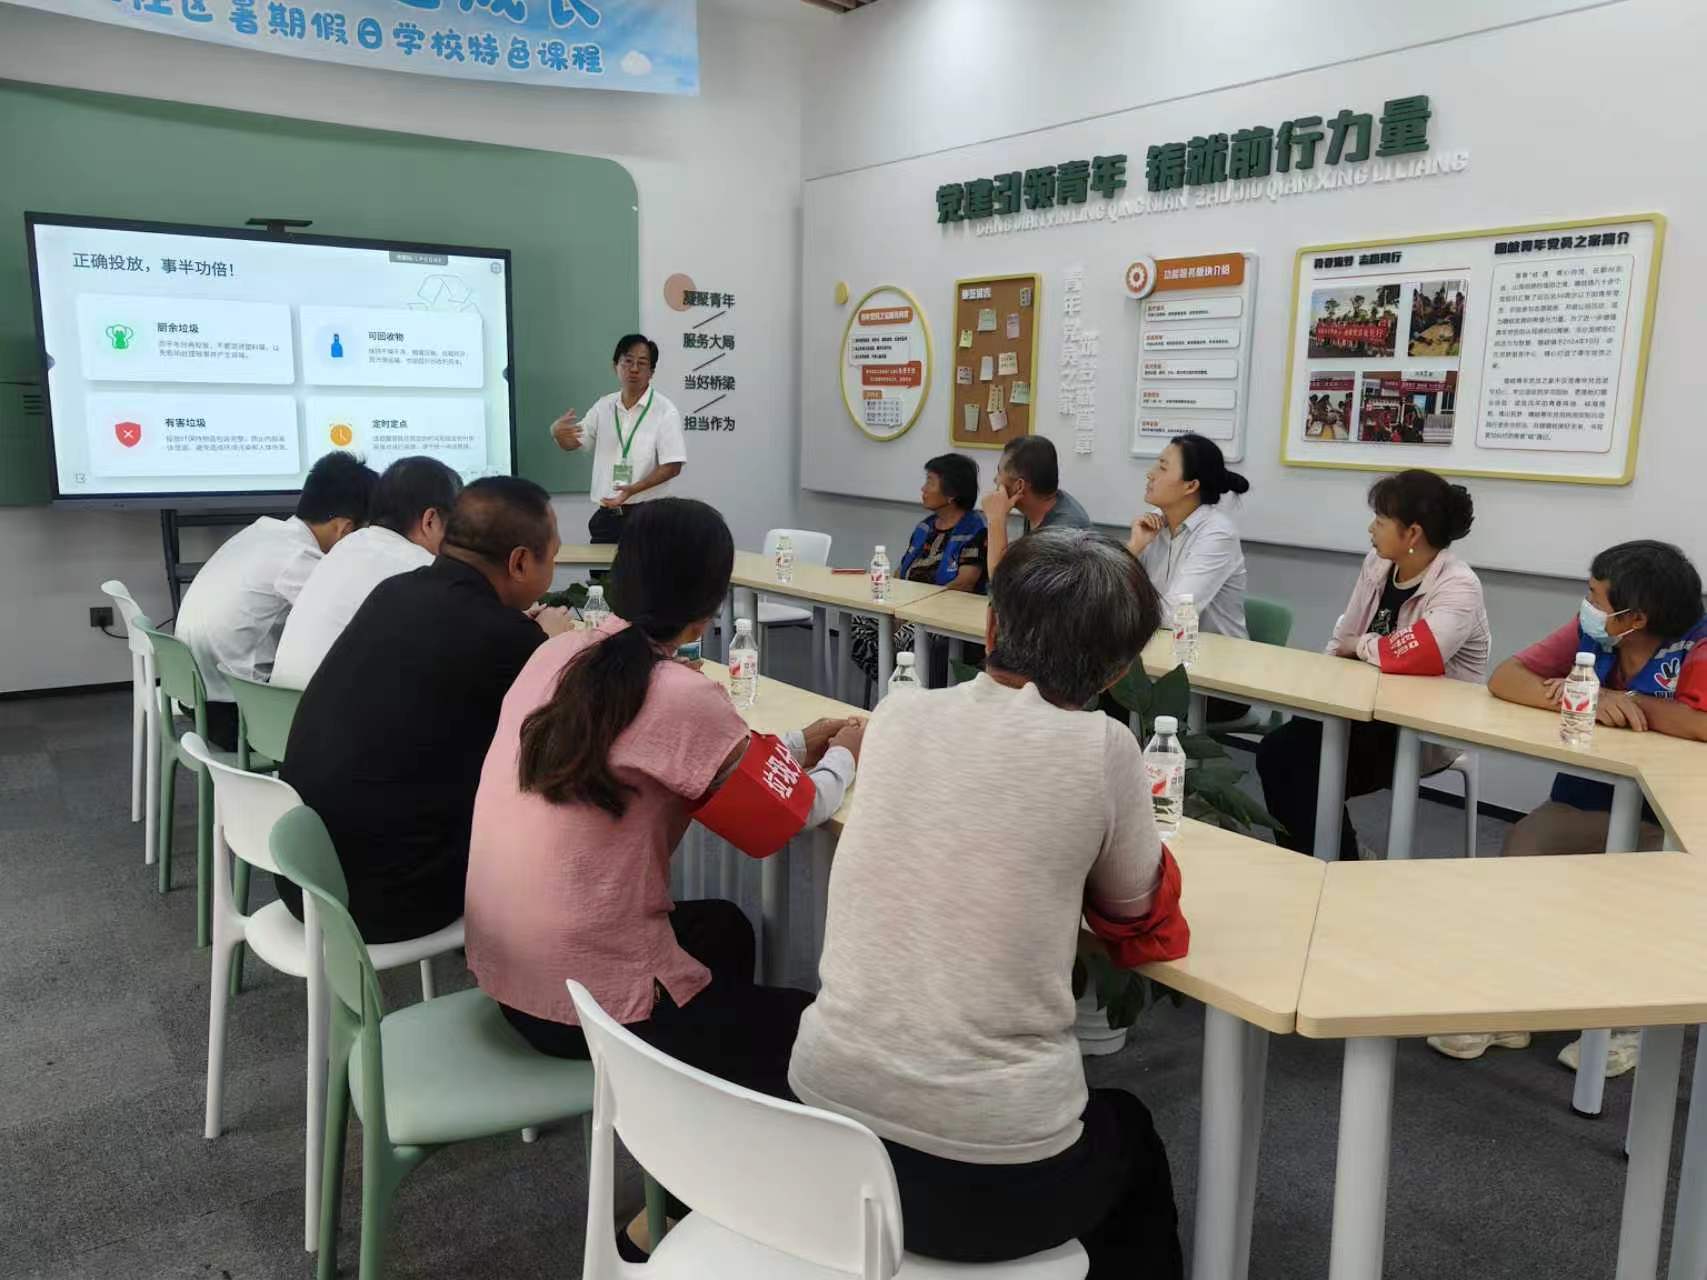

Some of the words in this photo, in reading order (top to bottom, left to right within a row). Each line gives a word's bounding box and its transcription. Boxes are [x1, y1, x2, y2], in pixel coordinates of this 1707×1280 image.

[935, 154, 1128, 224] 党建引领青年
[1145, 95, 1432, 193] 铸就前行力量
[157, 321, 200, 334] 厨余垃圾
[367, 331, 405, 343] 可回收物
[682, 332, 736, 351] 服务大局
[684, 375, 736, 391] 当好桥梁
[165, 417, 207, 429] 有害垃圾
[372, 418, 408, 430] 定时定点
[684, 415, 736, 432] 担当作为
